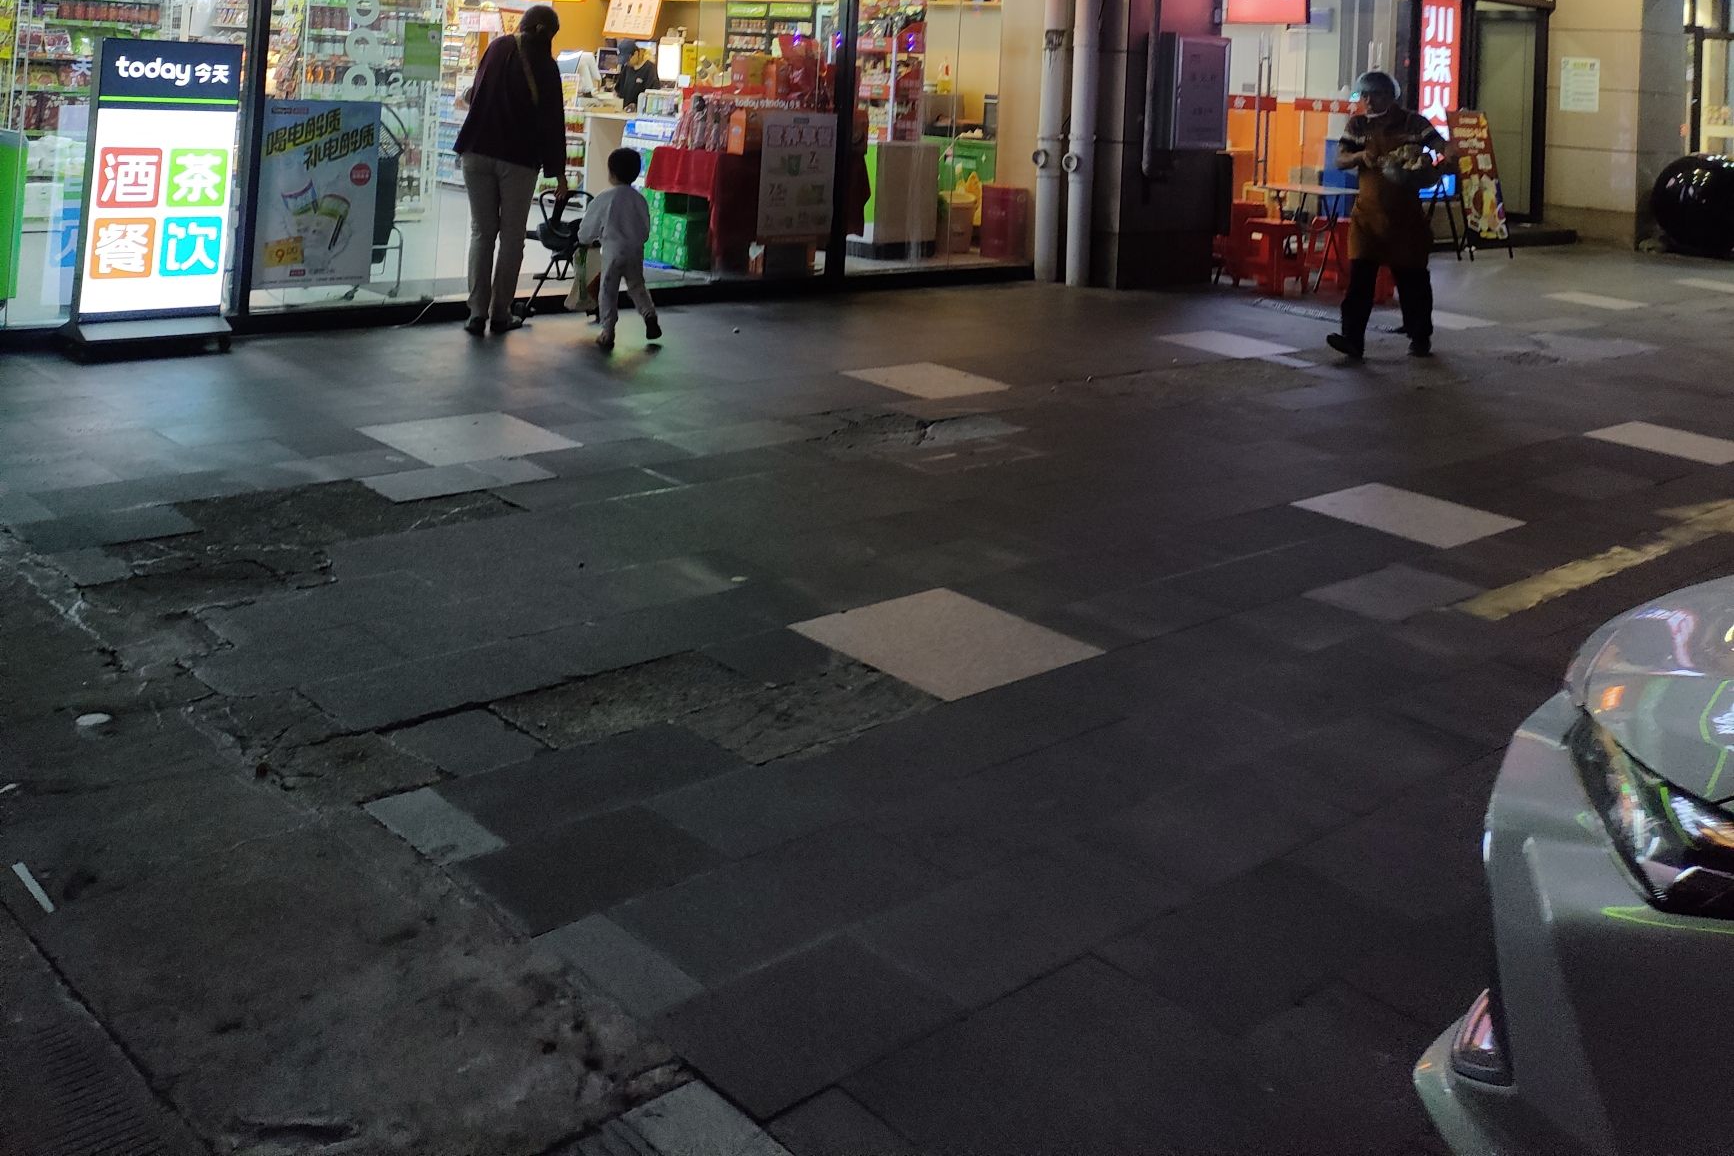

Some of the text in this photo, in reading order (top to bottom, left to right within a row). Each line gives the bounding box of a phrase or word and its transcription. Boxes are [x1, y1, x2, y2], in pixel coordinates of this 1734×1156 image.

[115, 55, 229, 87] today 今天
[266, 107, 341, 156] 喝电解质
[303, 122, 375, 171] 补电解质
[101, 152, 222, 203] 酒 茶
[94, 221, 216, 275] 餐 饮
